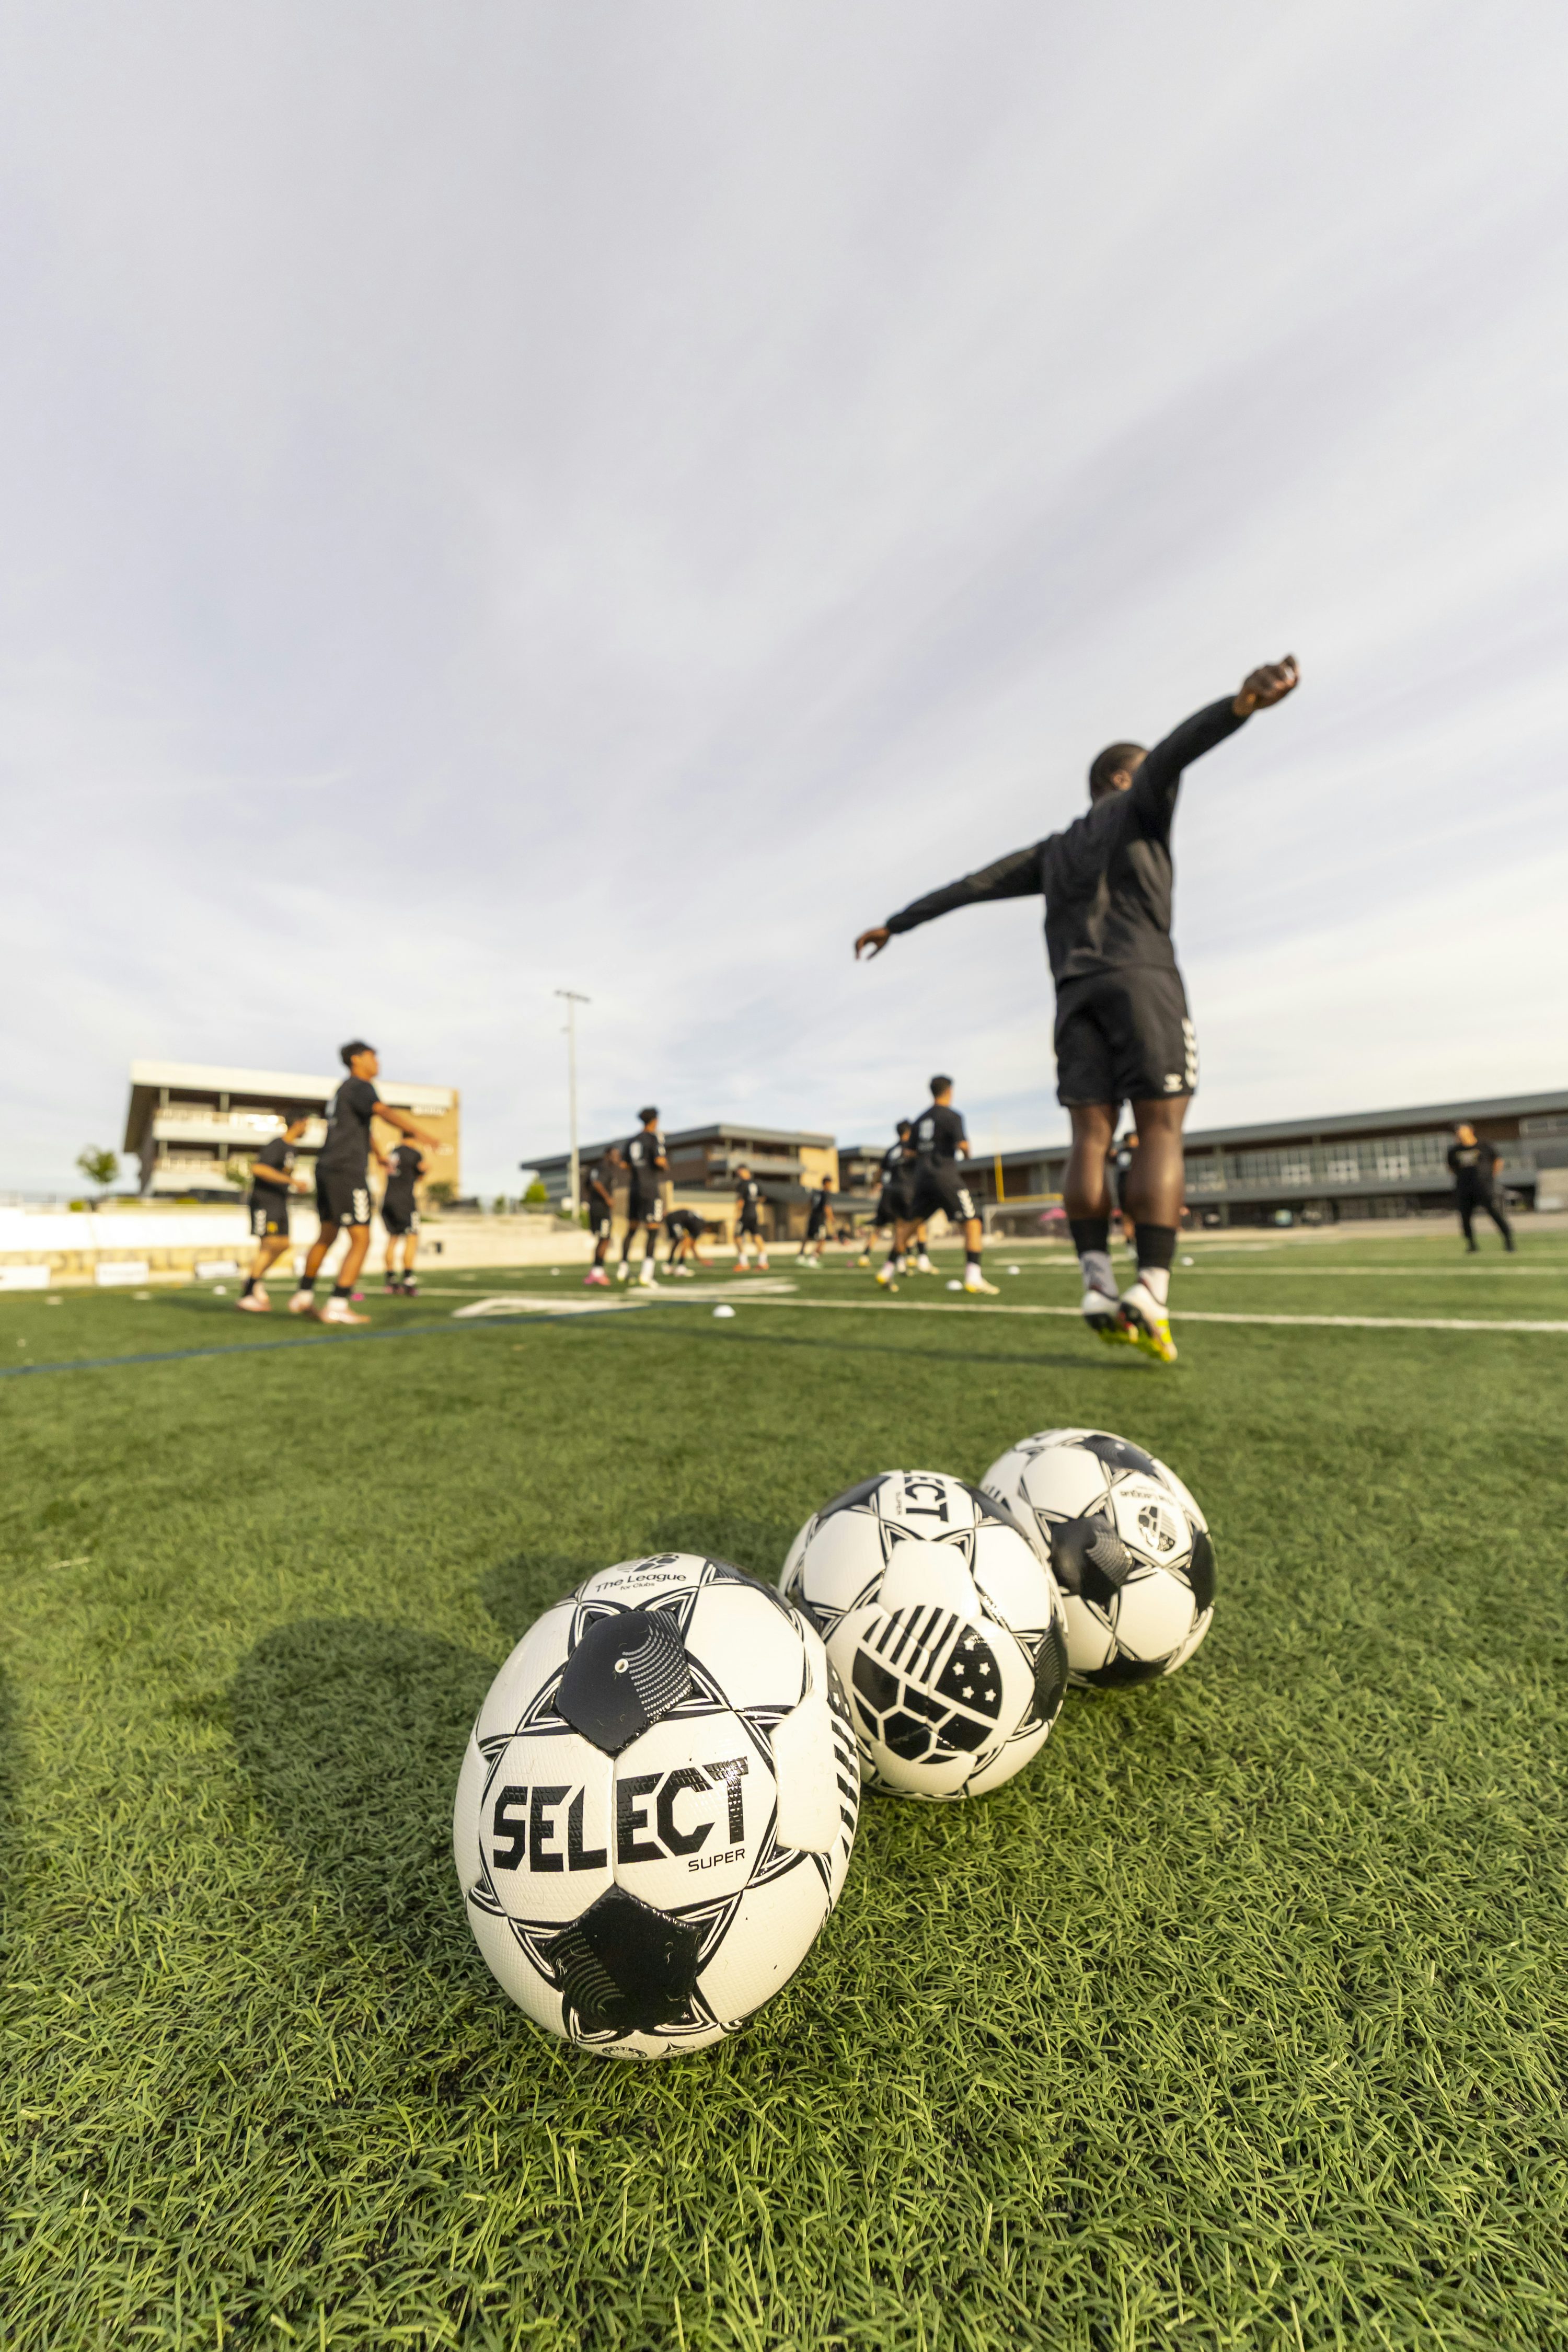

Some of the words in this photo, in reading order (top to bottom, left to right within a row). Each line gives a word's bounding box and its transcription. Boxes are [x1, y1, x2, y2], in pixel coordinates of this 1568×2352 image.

[903, 1470, 949, 1523] ECT
[595, 1578, 624, 1593] The
[627, 1574, 687, 1583] League
[493, 1756, 750, 1873] SELECT
[688, 1848, 746, 1873] SUPER
